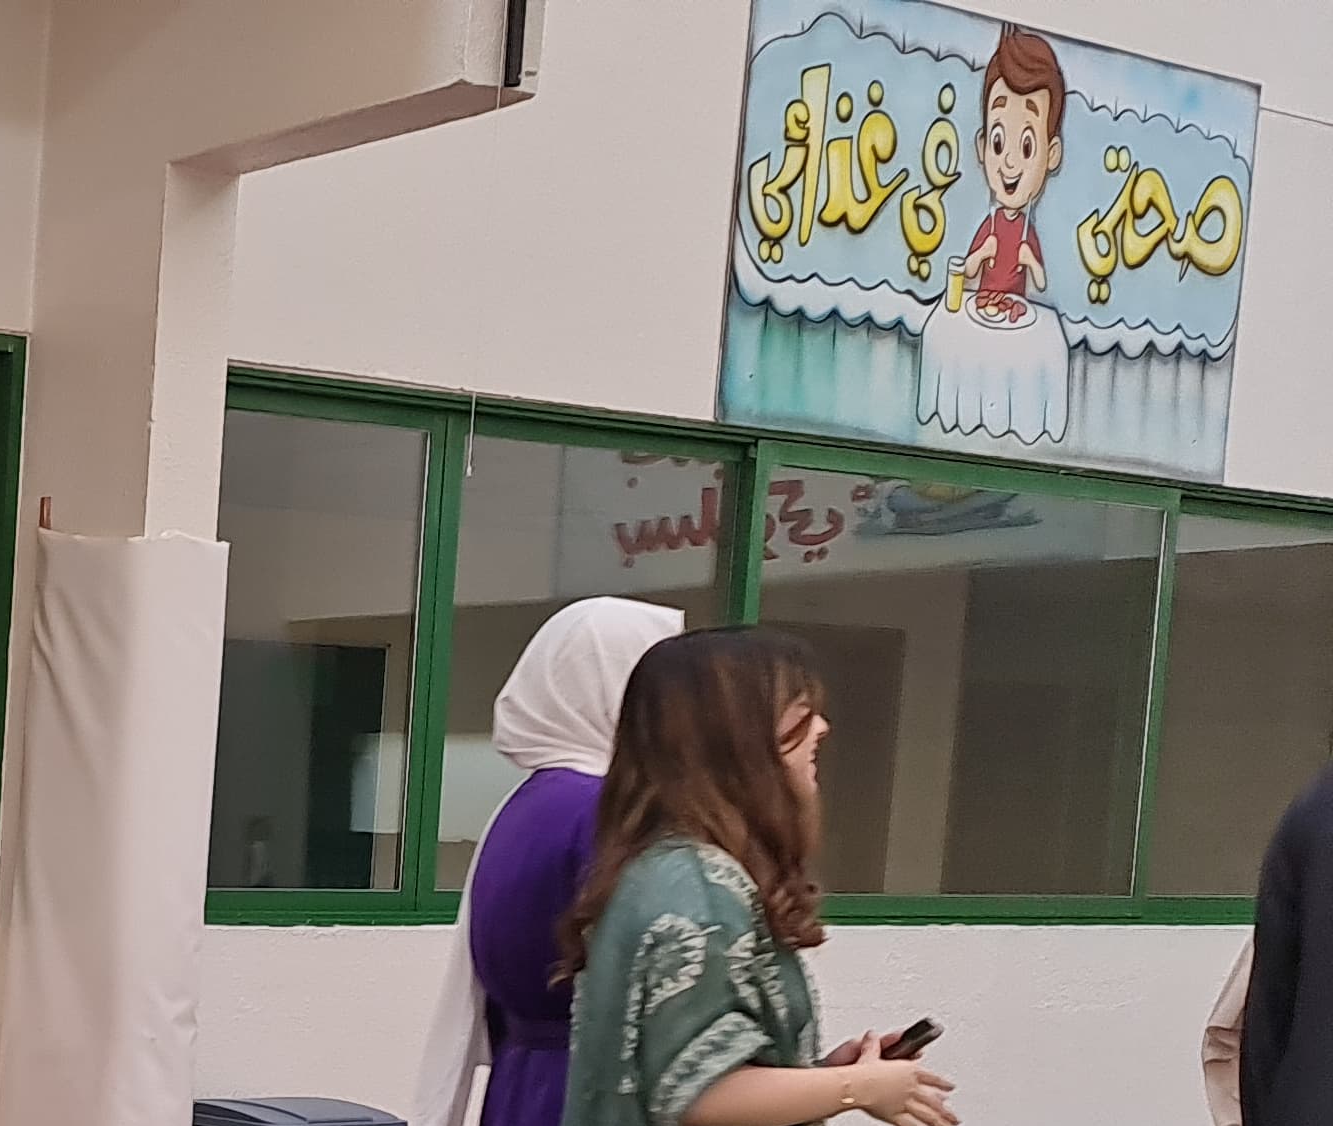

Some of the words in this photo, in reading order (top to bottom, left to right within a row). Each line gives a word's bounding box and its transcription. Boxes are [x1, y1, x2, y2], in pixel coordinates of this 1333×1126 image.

[748, 63, 909, 264] غذائي
[899, 83, 962, 282] في
[1076, 145, 1245, 305] صحتي
